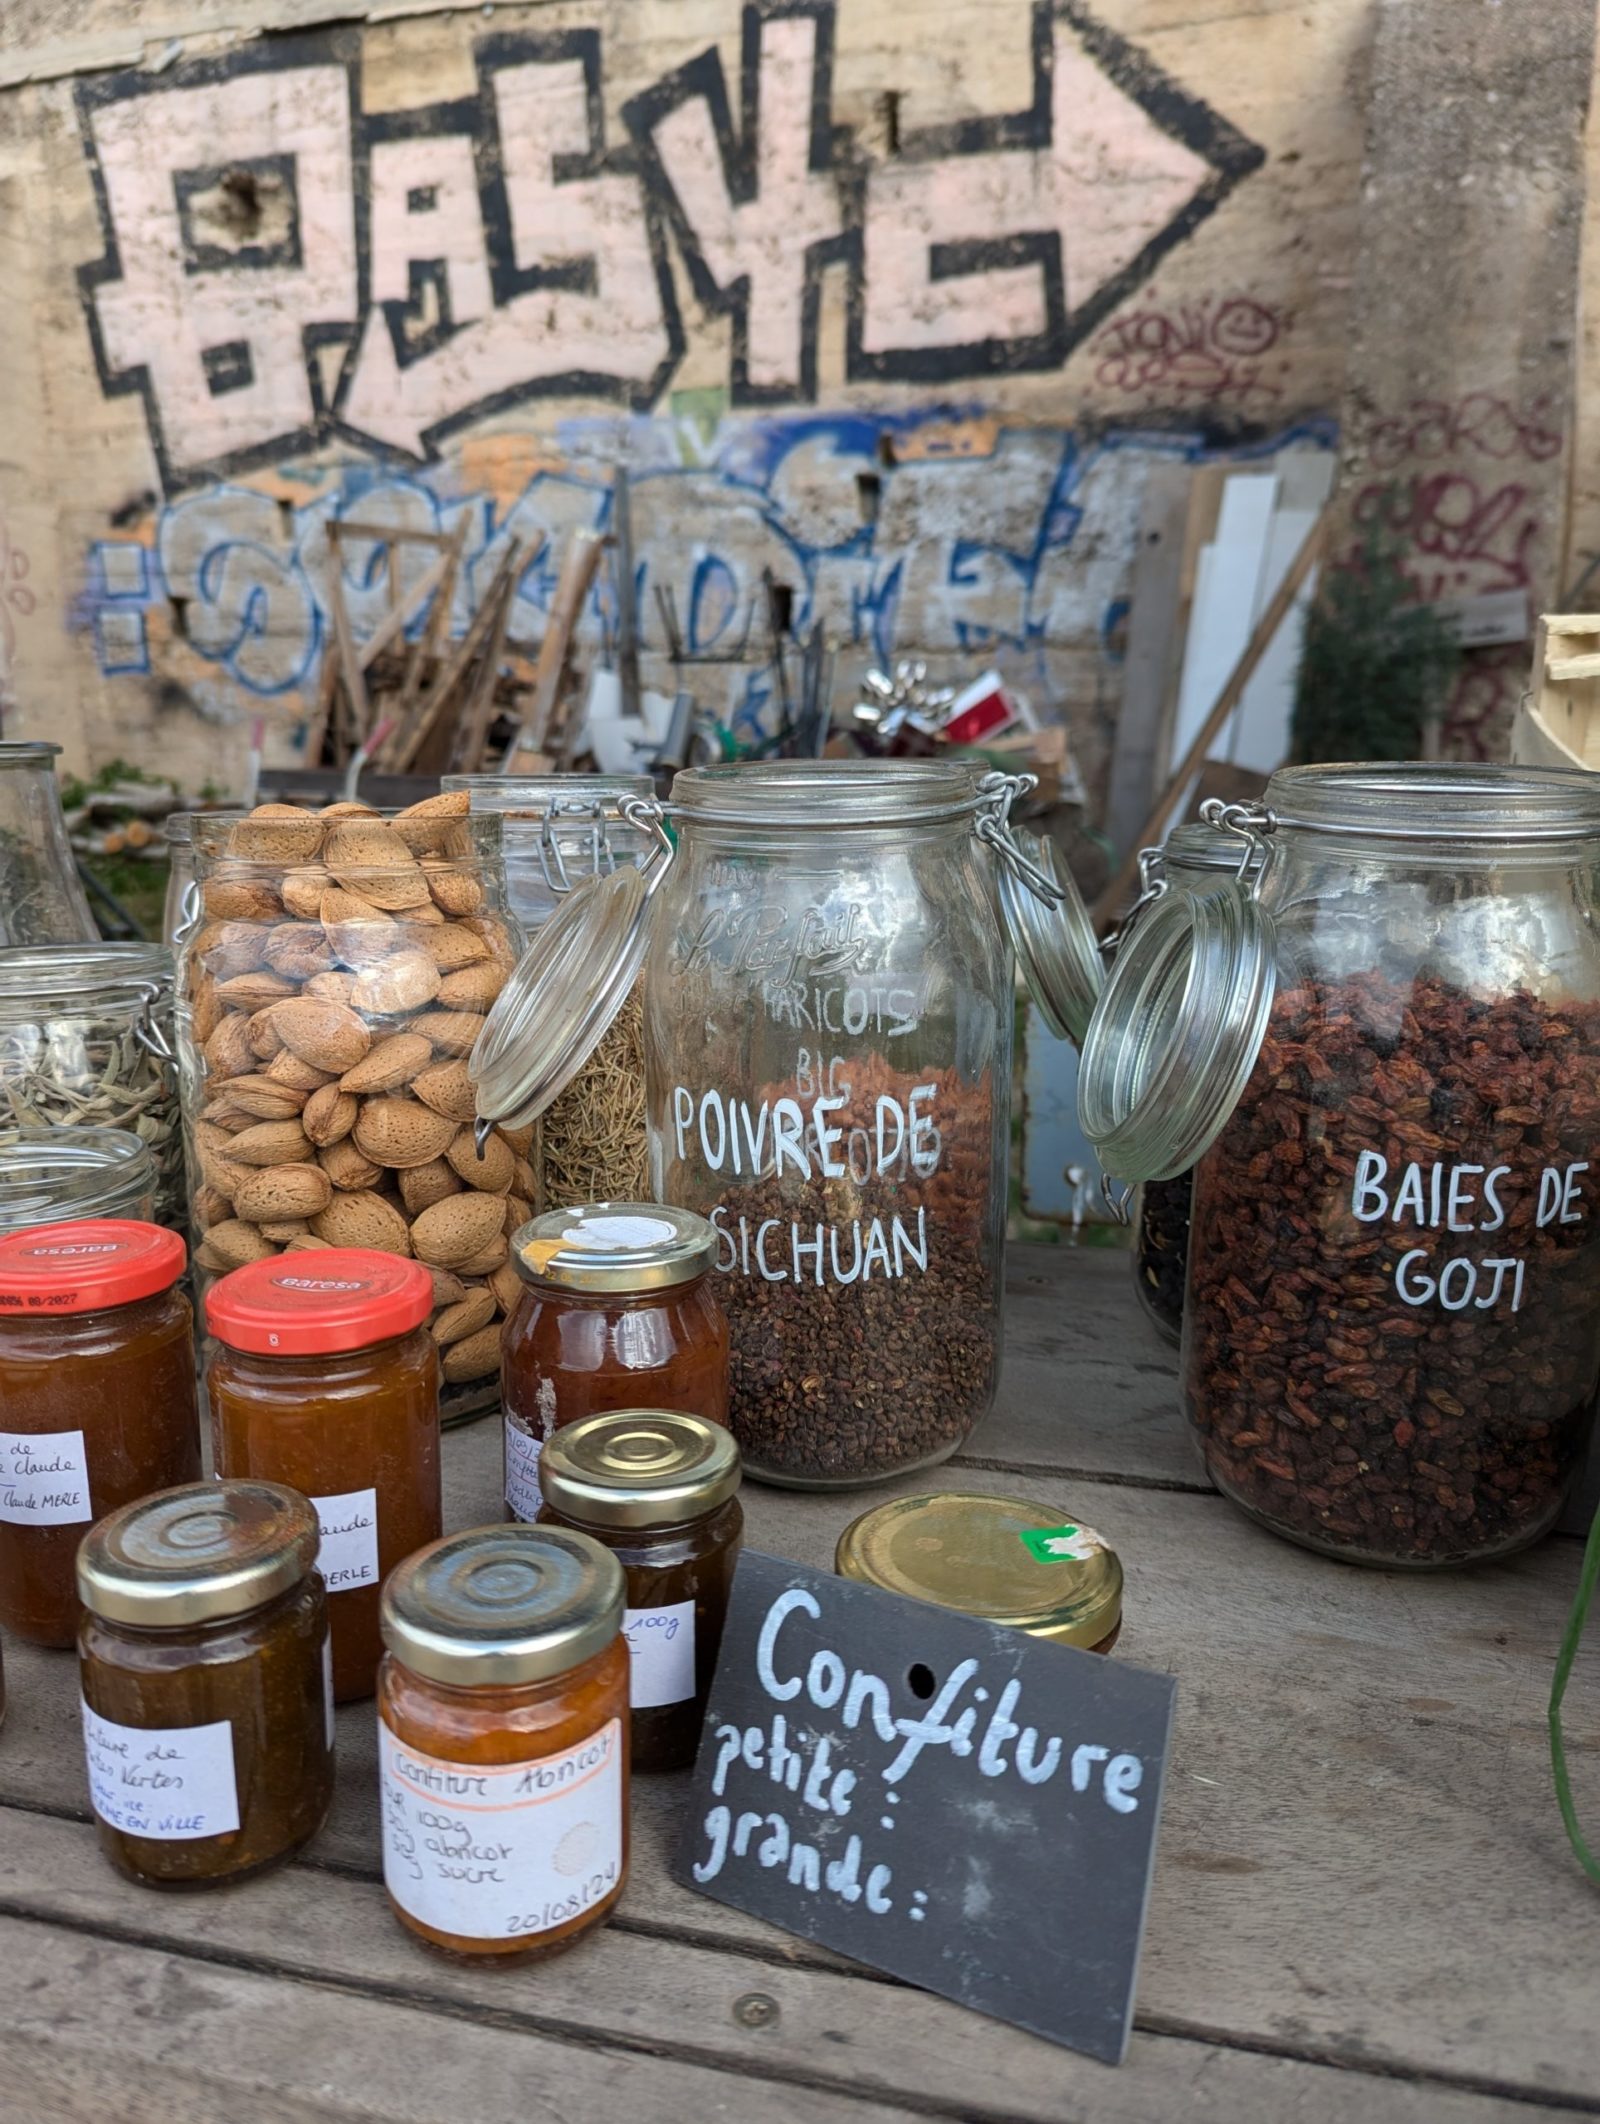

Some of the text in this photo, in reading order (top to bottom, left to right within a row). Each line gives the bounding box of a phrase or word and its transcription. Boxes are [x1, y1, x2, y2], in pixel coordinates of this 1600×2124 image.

[674, 1083, 937, 1181] POIVRE DE
[1352, 1149, 1589, 1232] BAIES DE
[709, 1205, 928, 1287] SICHUAN
[280, 1276, 362, 1290] Baresa
[1395, 1249, 1525, 1312] GOJI
[10, 1442, 35, 1455] de
[14, 1456, 77, 1475] Claude
[41, 1492, 81, 1509] MERLE
[628, 1616, 680, 1640] 100g
[757, 1588, 1143, 1814] Confiture
[145, 1743, 187, 1761] de
[712, 1714, 857, 1816] petite
[121, 1764, 184, 1789] Vertes
[693, 1806, 892, 1915] grande
